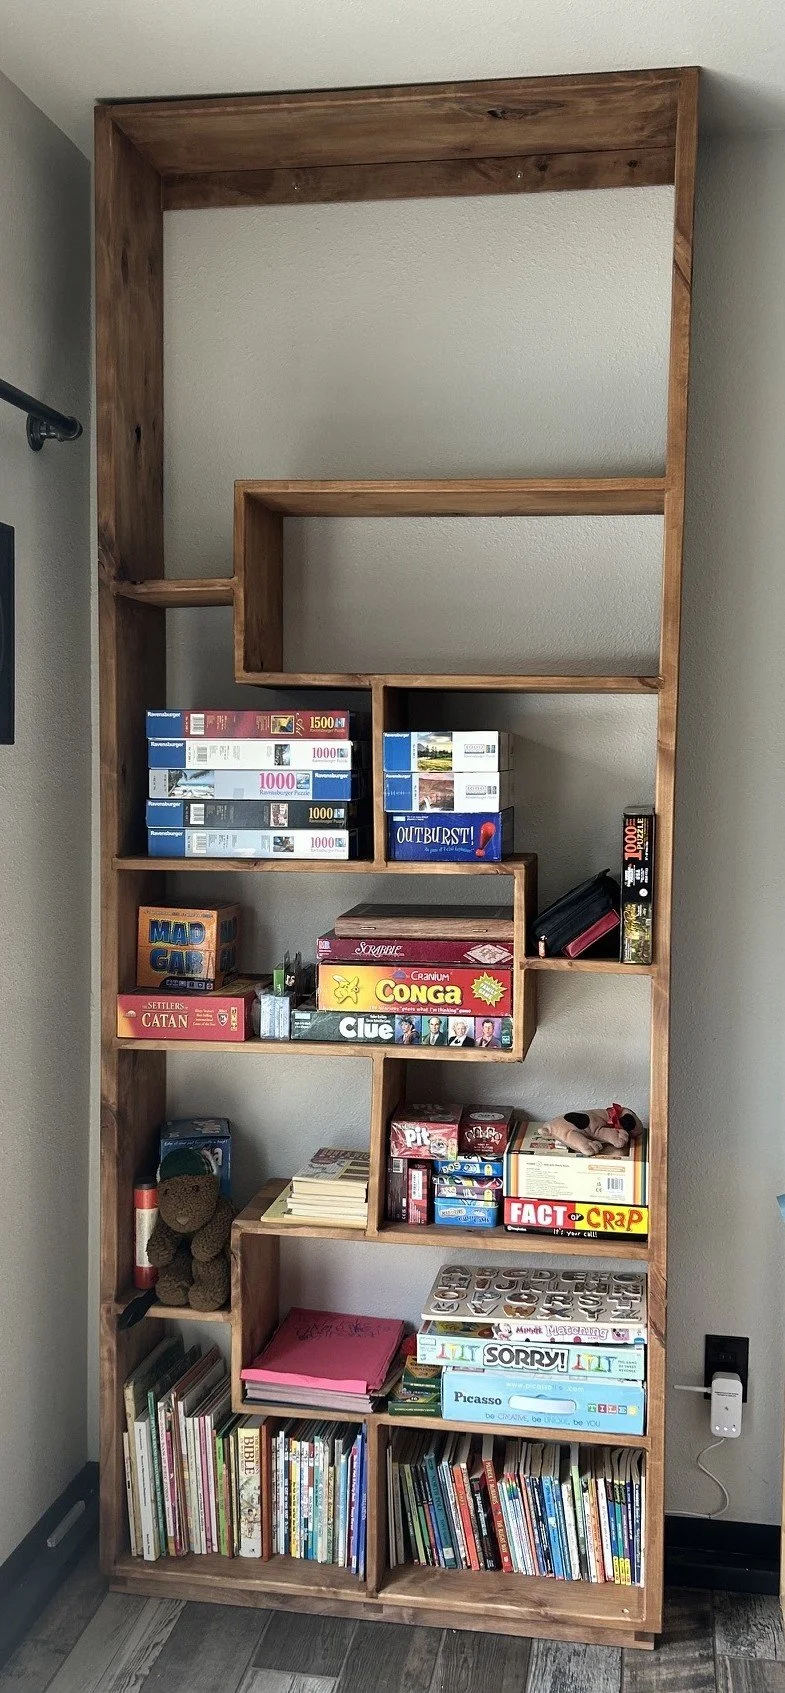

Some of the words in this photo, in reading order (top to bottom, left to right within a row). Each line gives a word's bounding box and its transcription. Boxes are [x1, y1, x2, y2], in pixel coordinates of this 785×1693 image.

[310, 716, 334, 728] 1500
[312, 748, 336, 758] 1000
[260, 772, 295, 789] 1000
[309, 808, 333, 819] 1000
[311, 837, 334, 848] 1000
[397, 826, 474, 845] OUTBURST!
[625, 825, 642, 860] 1000
[150, 920, 205, 946] MAD
[355, 942, 402, 957] SCRABBLE
[150, 948, 203, 975] GAB
[142, 1013, 188, 1028] CATAN
[340, 1017, 393, 1039] Clue
[406, 1127, 430, 1148] Pit
[510, 1202, 567, 1226] FACT
[545, 1325, 608, 1340] Matching
[485, 1345, 566, 1370] SORRY!
[454, 1391, 502, 1406] Picasso
[244, 1435, 255, 1475] BIBLE
[485, 1462, 493, 1478] PATRICK
